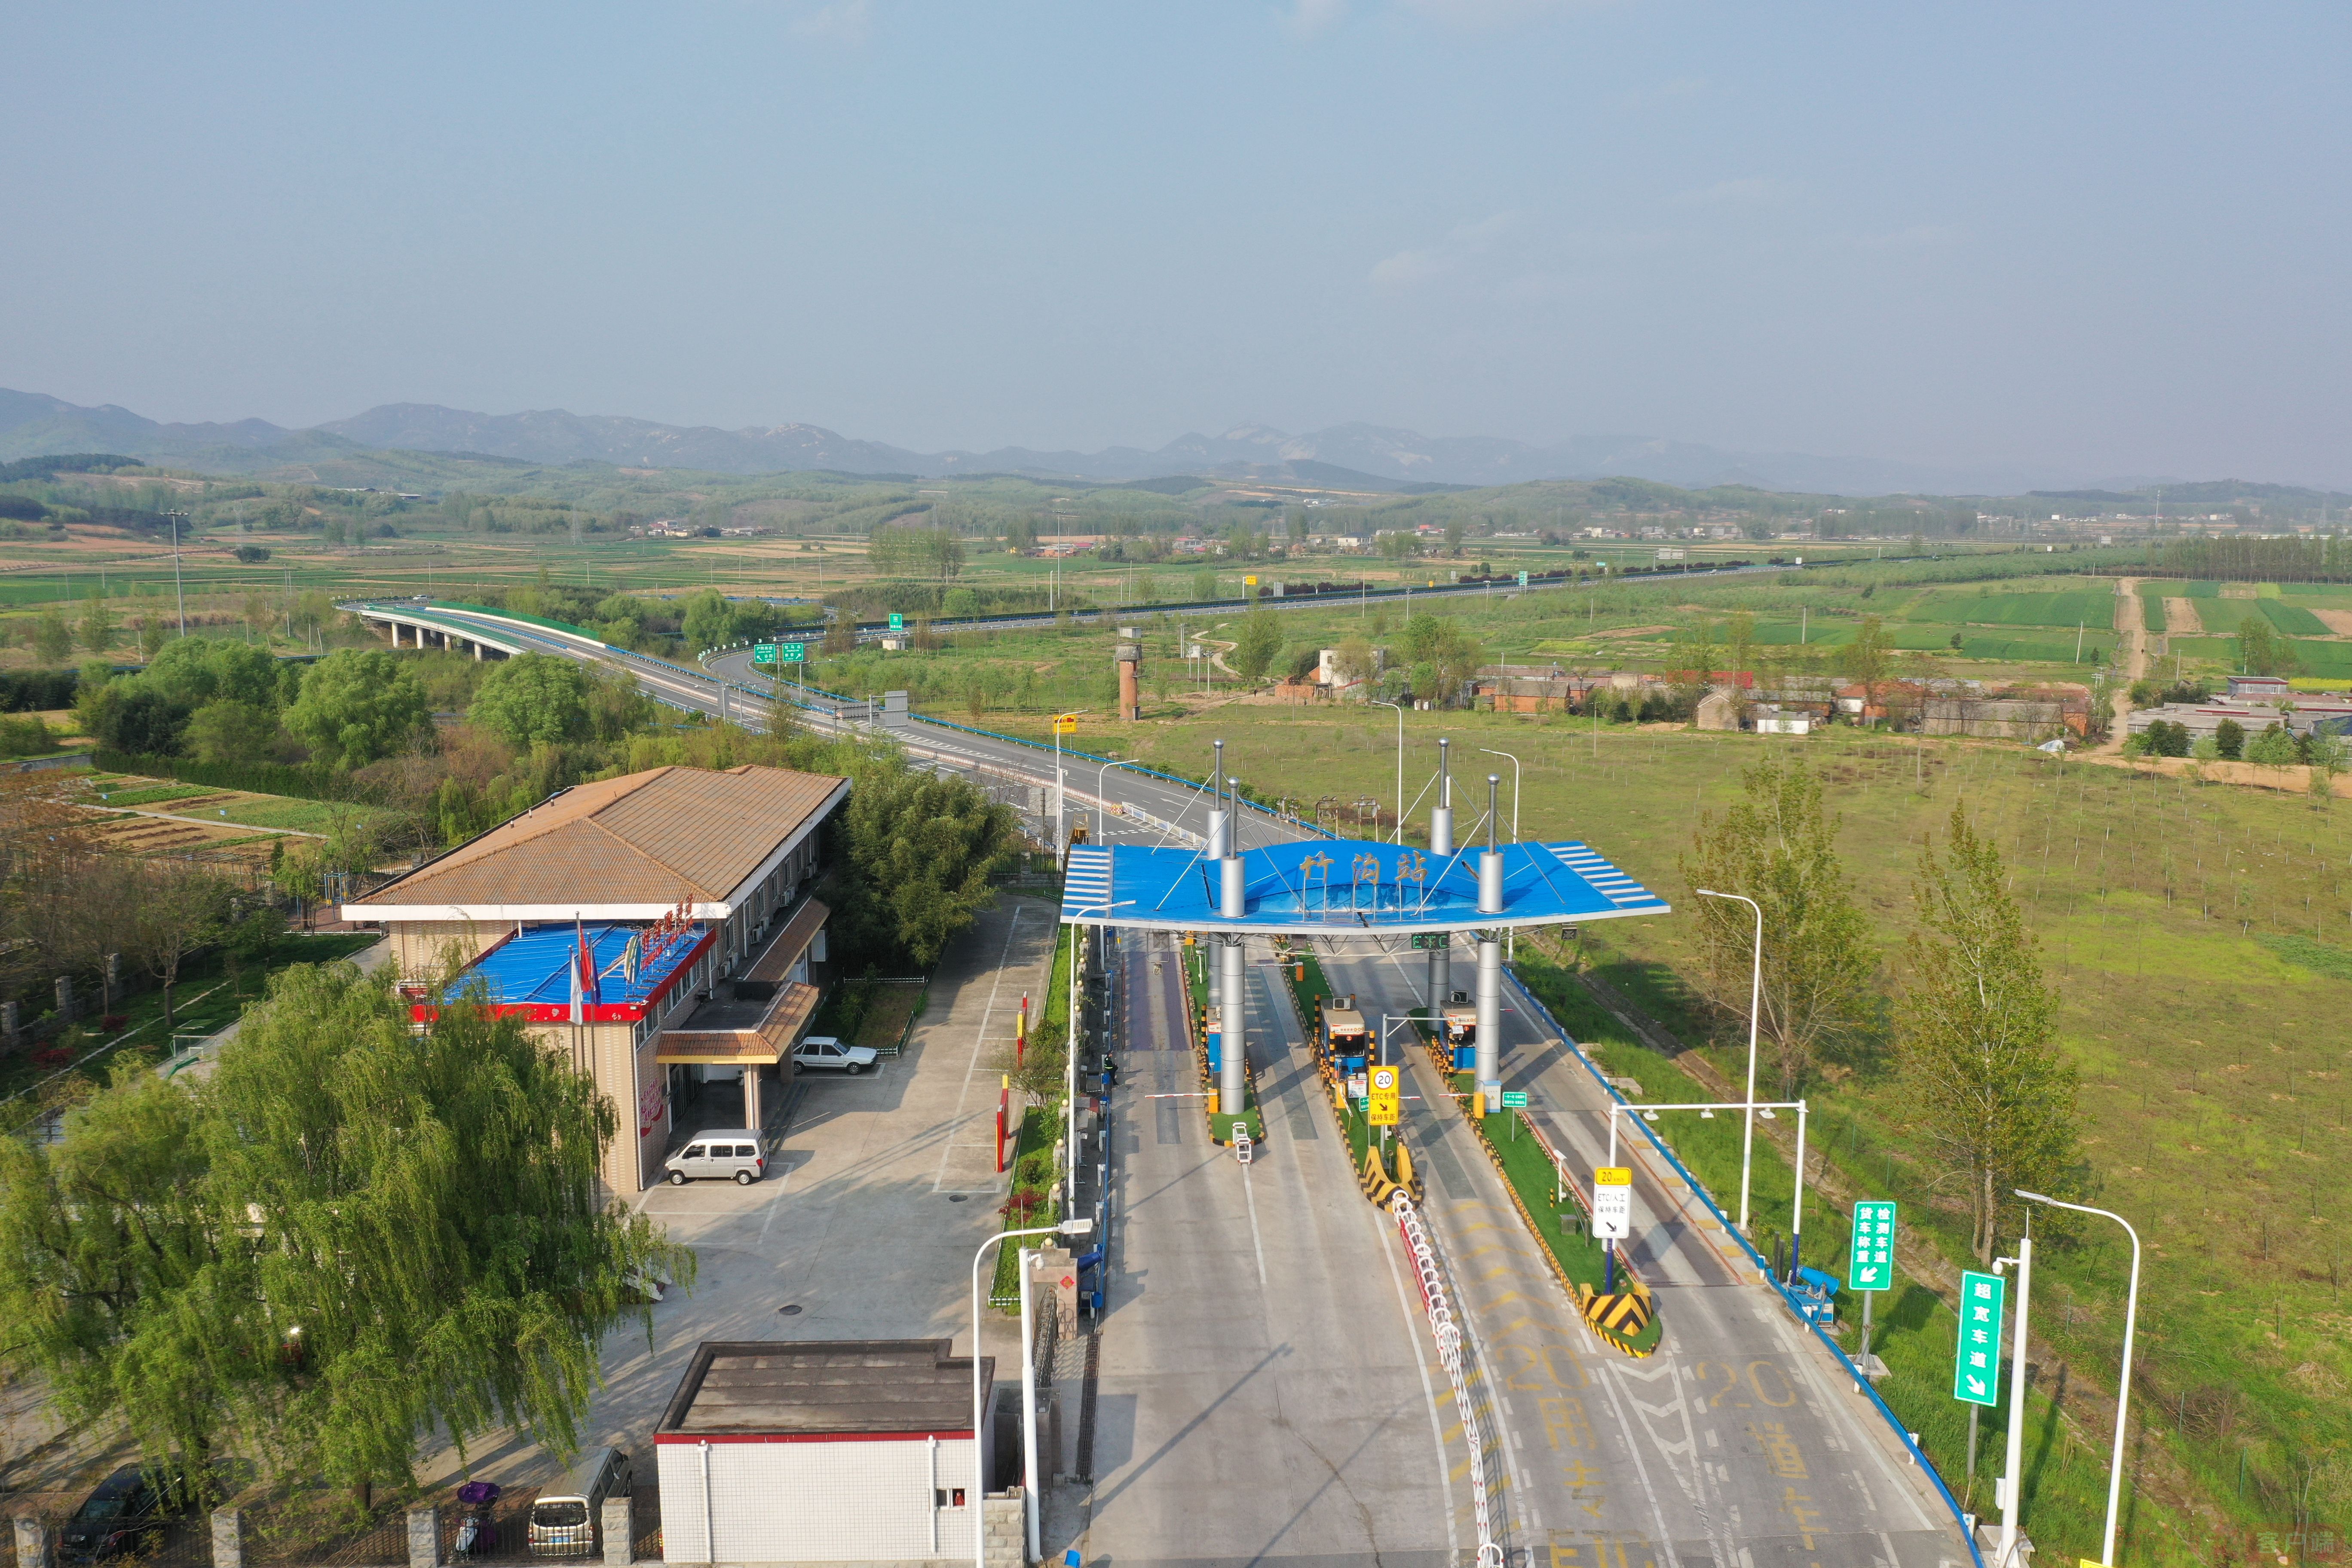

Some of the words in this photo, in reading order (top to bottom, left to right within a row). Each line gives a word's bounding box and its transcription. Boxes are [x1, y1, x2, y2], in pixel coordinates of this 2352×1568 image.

[1299, 850, 1428, 886] 竹沟站
[1412, 935, 1448, 949] ETC
[1378, 1075, 1390, 1084] 20
[1371, 1092, 1396, 1100] ETC专用
[1371, 1113, 1396, 1121] 保持车距
[1601, 1171, 1612, 1182] 20
[1598, 1206, 1626, 1214] 保持车距
[1855, 1207, 1873, 1263] 货车称重
[1873, 1207, 1891, 1264] 检测车道
[1969, 1282, 1991, 1369] 超宽车道
[1496, 1344, 1590, 1391] 20
[1696, 1360, 1798, 1408] 20
